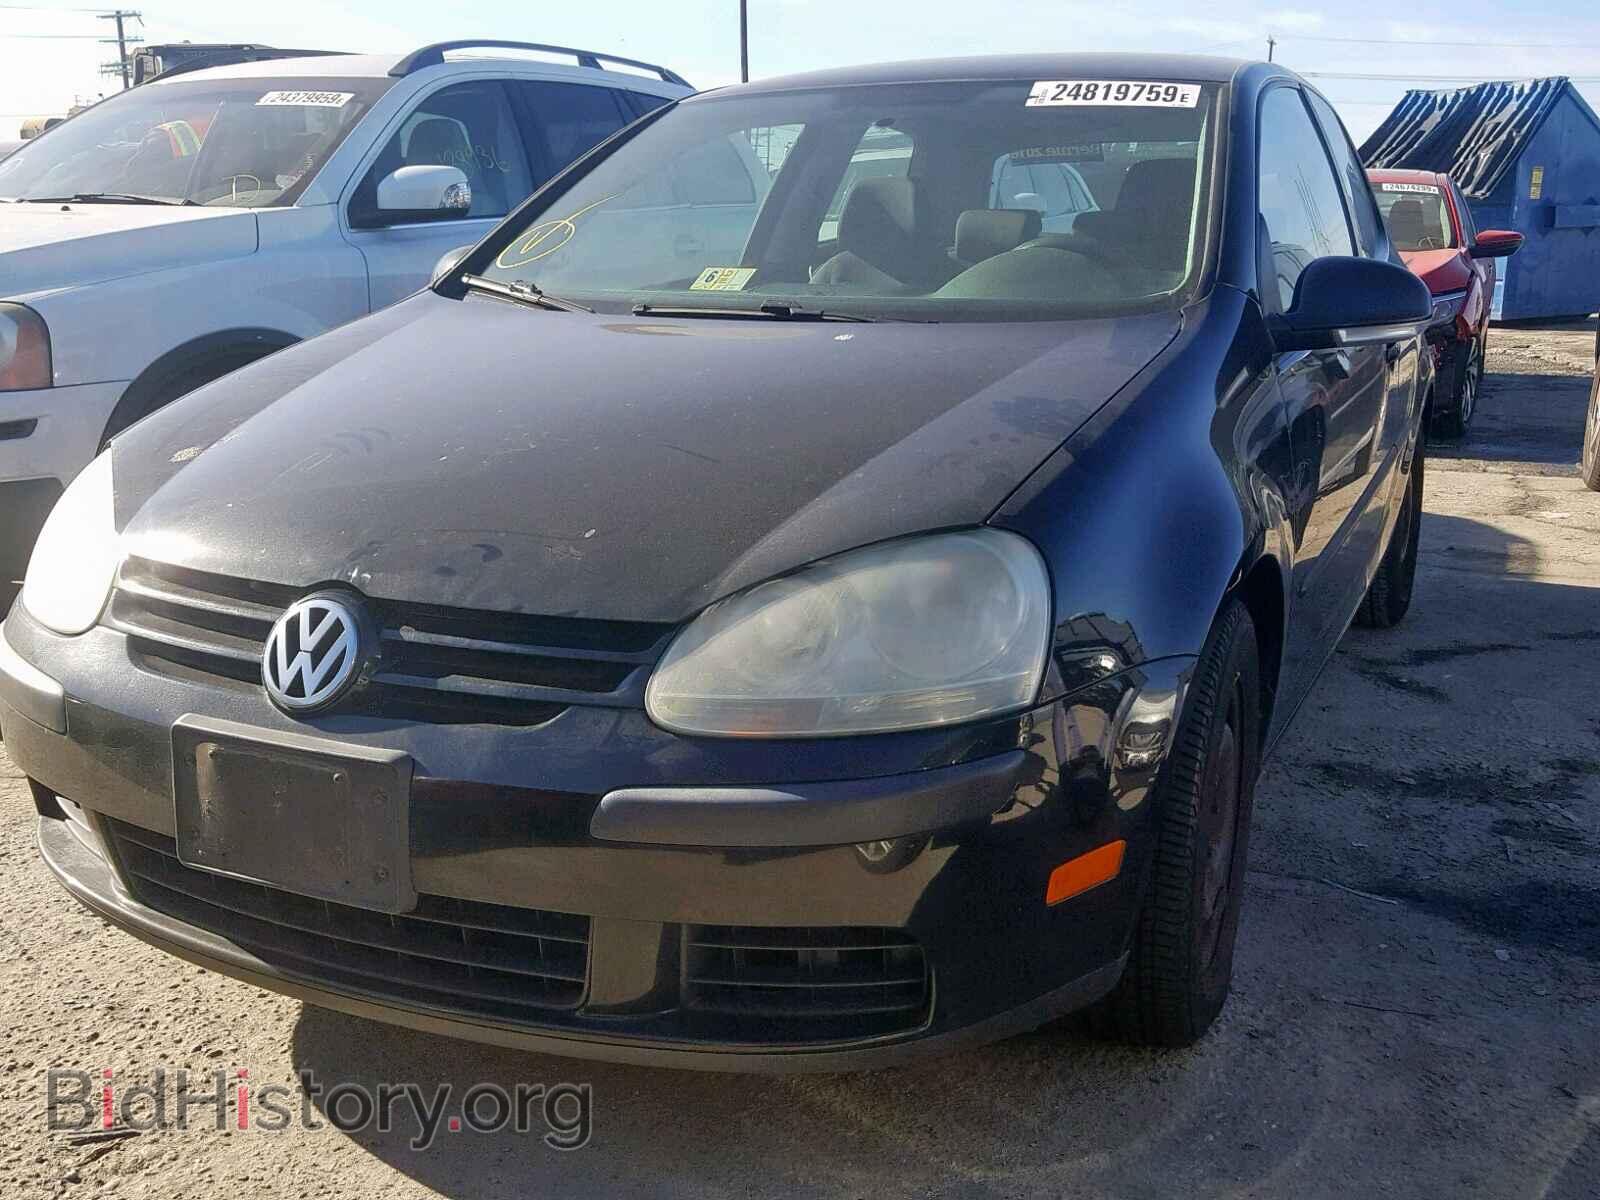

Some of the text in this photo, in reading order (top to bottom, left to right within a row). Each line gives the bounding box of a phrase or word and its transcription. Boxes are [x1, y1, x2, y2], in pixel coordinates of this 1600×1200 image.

[270, 92, 341, 104] 24379959
[1050, 83, 1178, 102] 24819759
[1180, 93, 1190, 103] E
